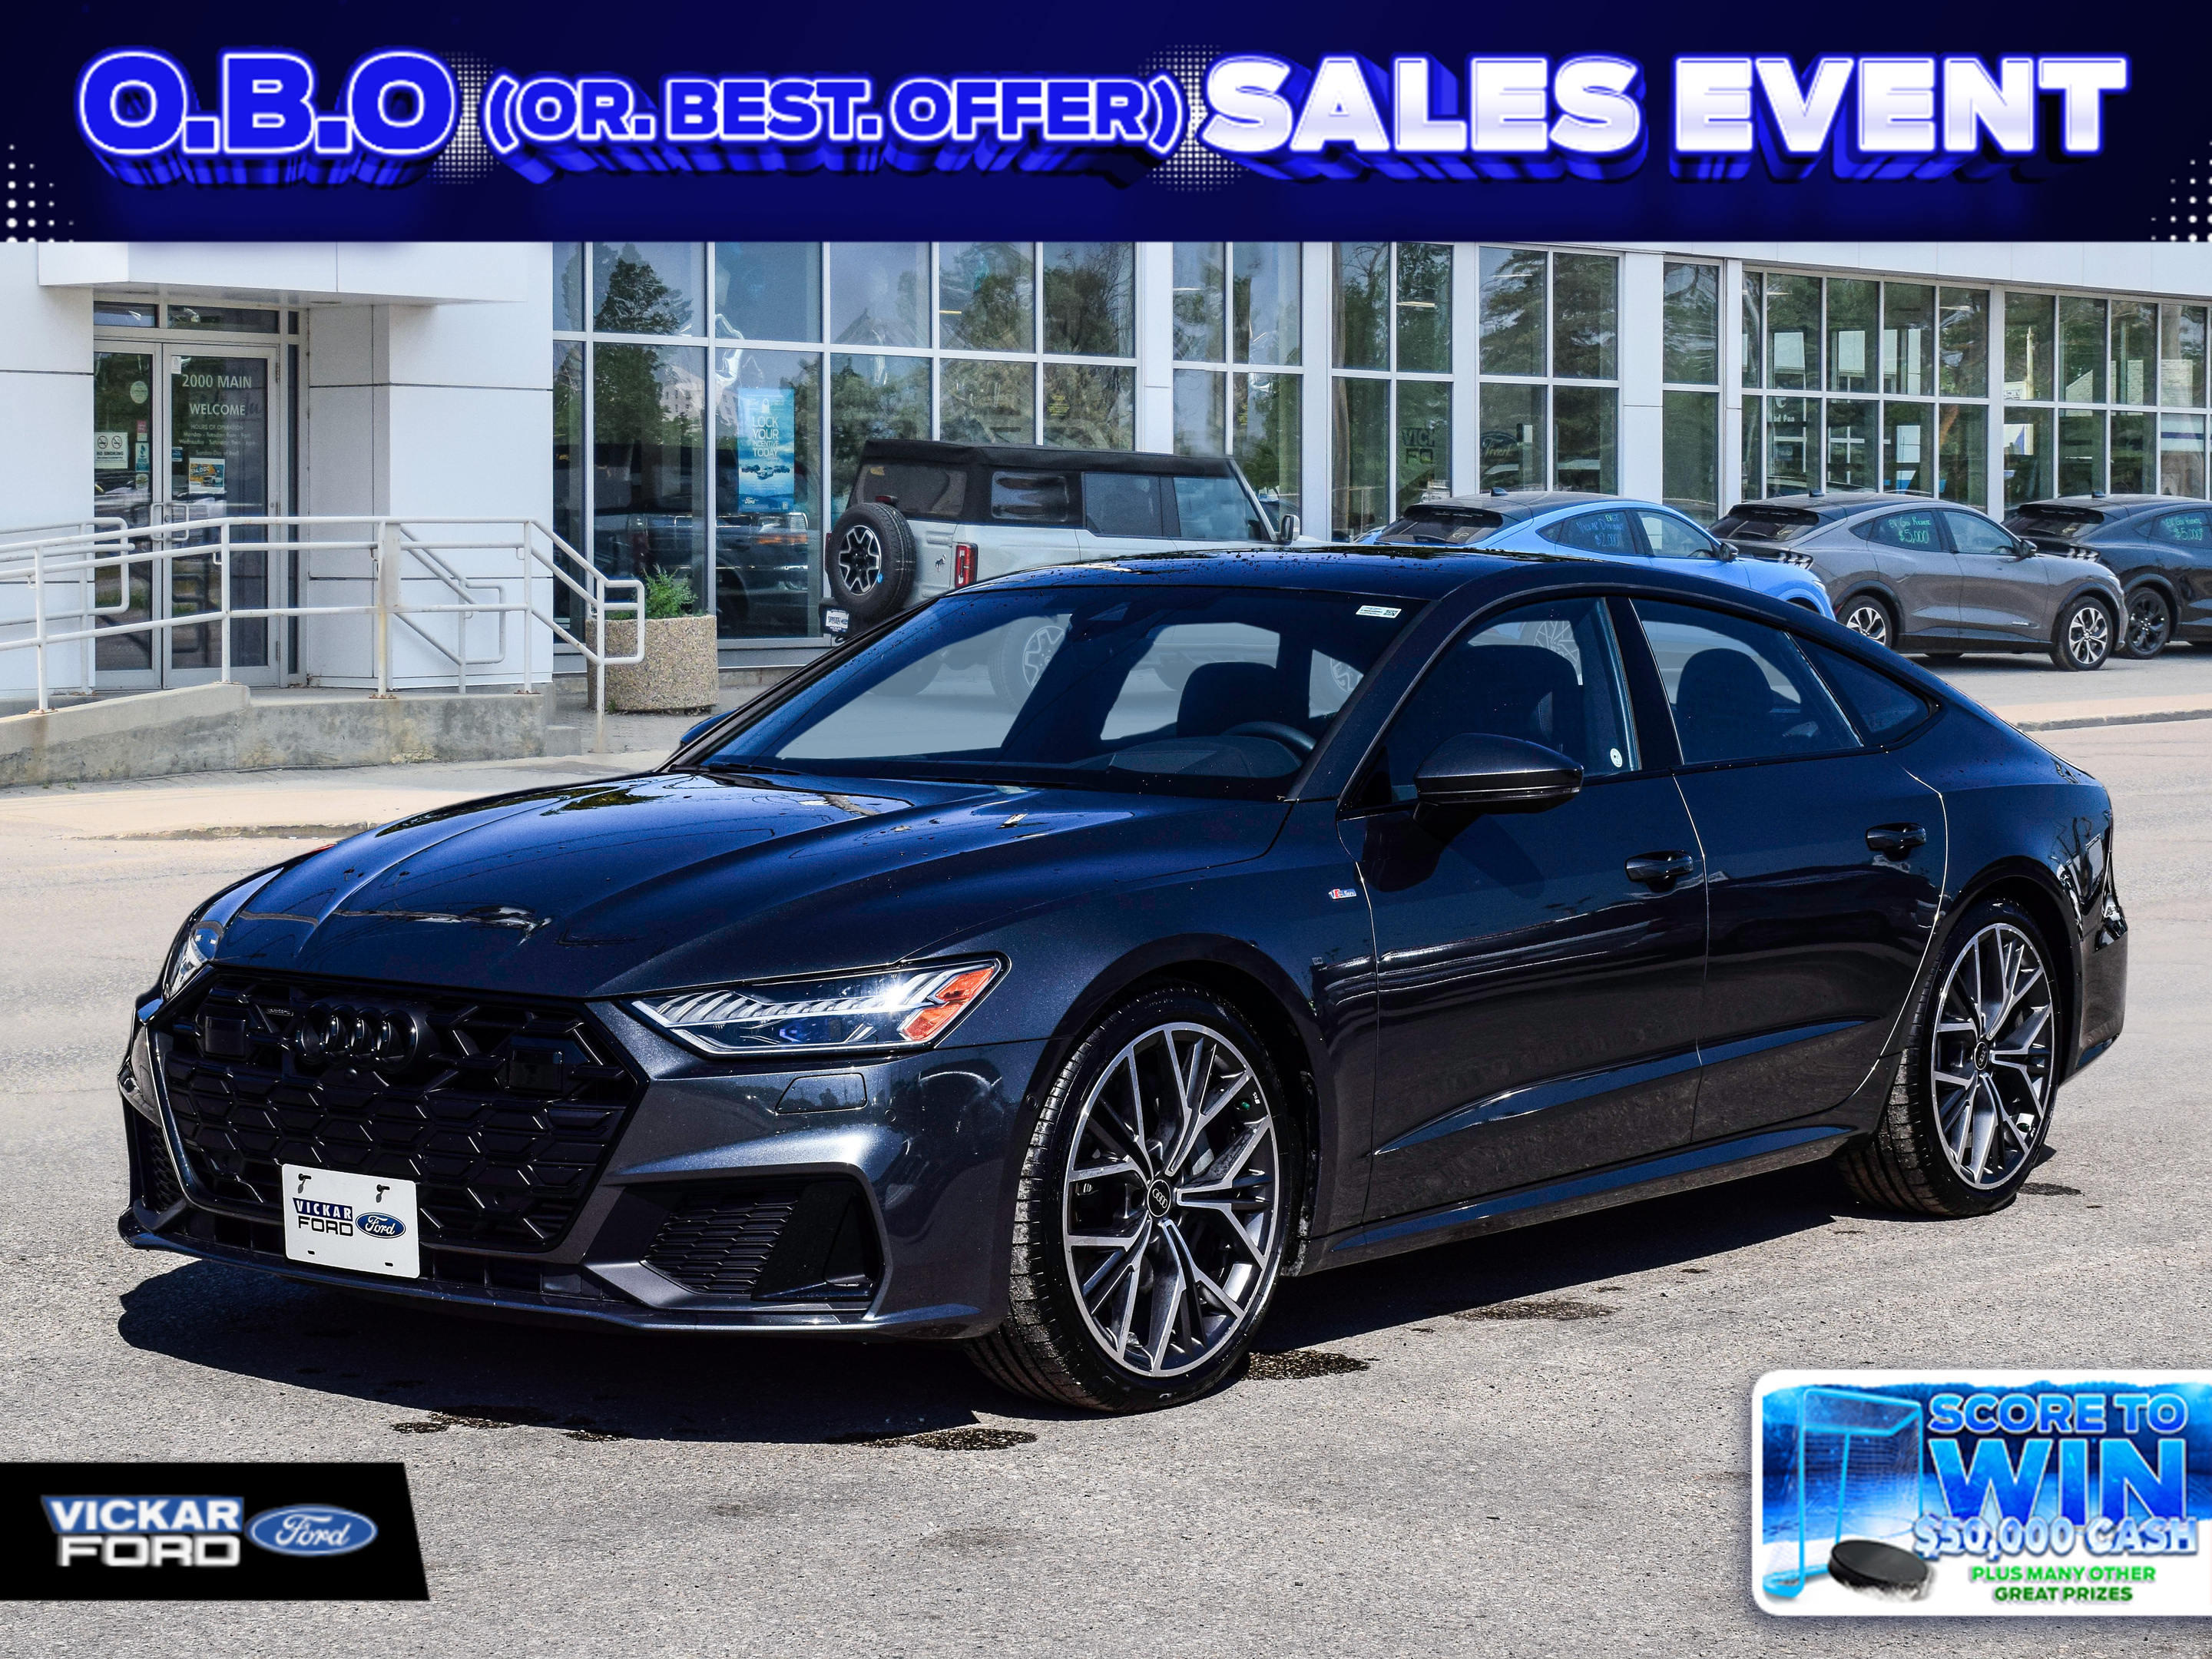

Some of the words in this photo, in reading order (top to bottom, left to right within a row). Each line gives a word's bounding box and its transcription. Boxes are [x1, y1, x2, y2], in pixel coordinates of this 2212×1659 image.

[182, 374, 214, 388] 2000
[217, 375, 252, 389] MAIN
[189, 403, 246, 416] WELCOME
[752, 416, 779, 428] LOCK
[752, 429, 780, 440] YOUR
[752, 448, 779, 457] TODAY
[1899, 528, 1929, 544] $5,000
[296, 1200, 353, 1220] VICKAR
[298, 1216, 354, 1237] FORD
[365, 1215, 396, 1235] Ford
